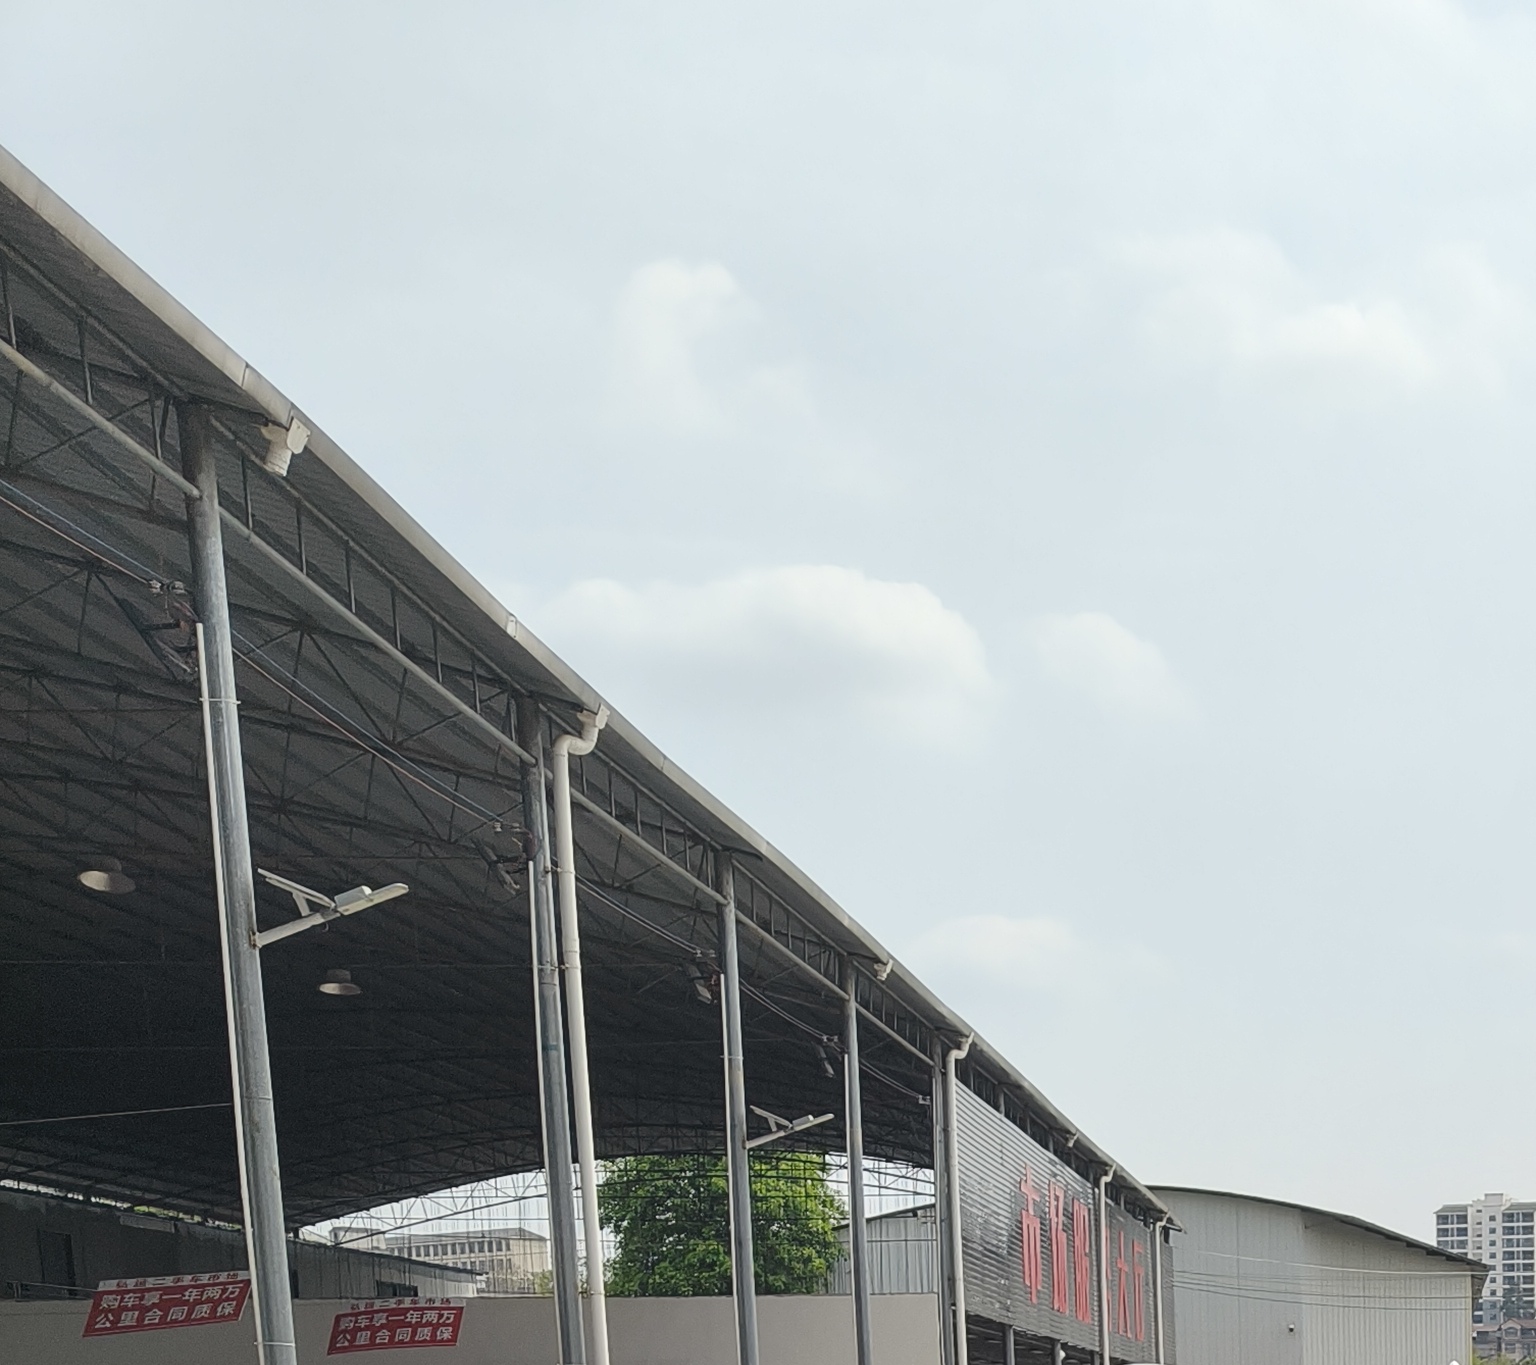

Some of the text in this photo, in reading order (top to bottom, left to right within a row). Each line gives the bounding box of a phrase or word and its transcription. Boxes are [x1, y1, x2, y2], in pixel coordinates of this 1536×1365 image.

[1020, 1164, 1144, 1342] 市场服大厅
[99, 1283, 244, 1310] 购车享一年两万
[94, 1301, 237, 1329] 公里合同质保
[339, 1310, 457, 1331] 购车享一年两万
[336, 1326, 453, 1347] 公里合同质保
